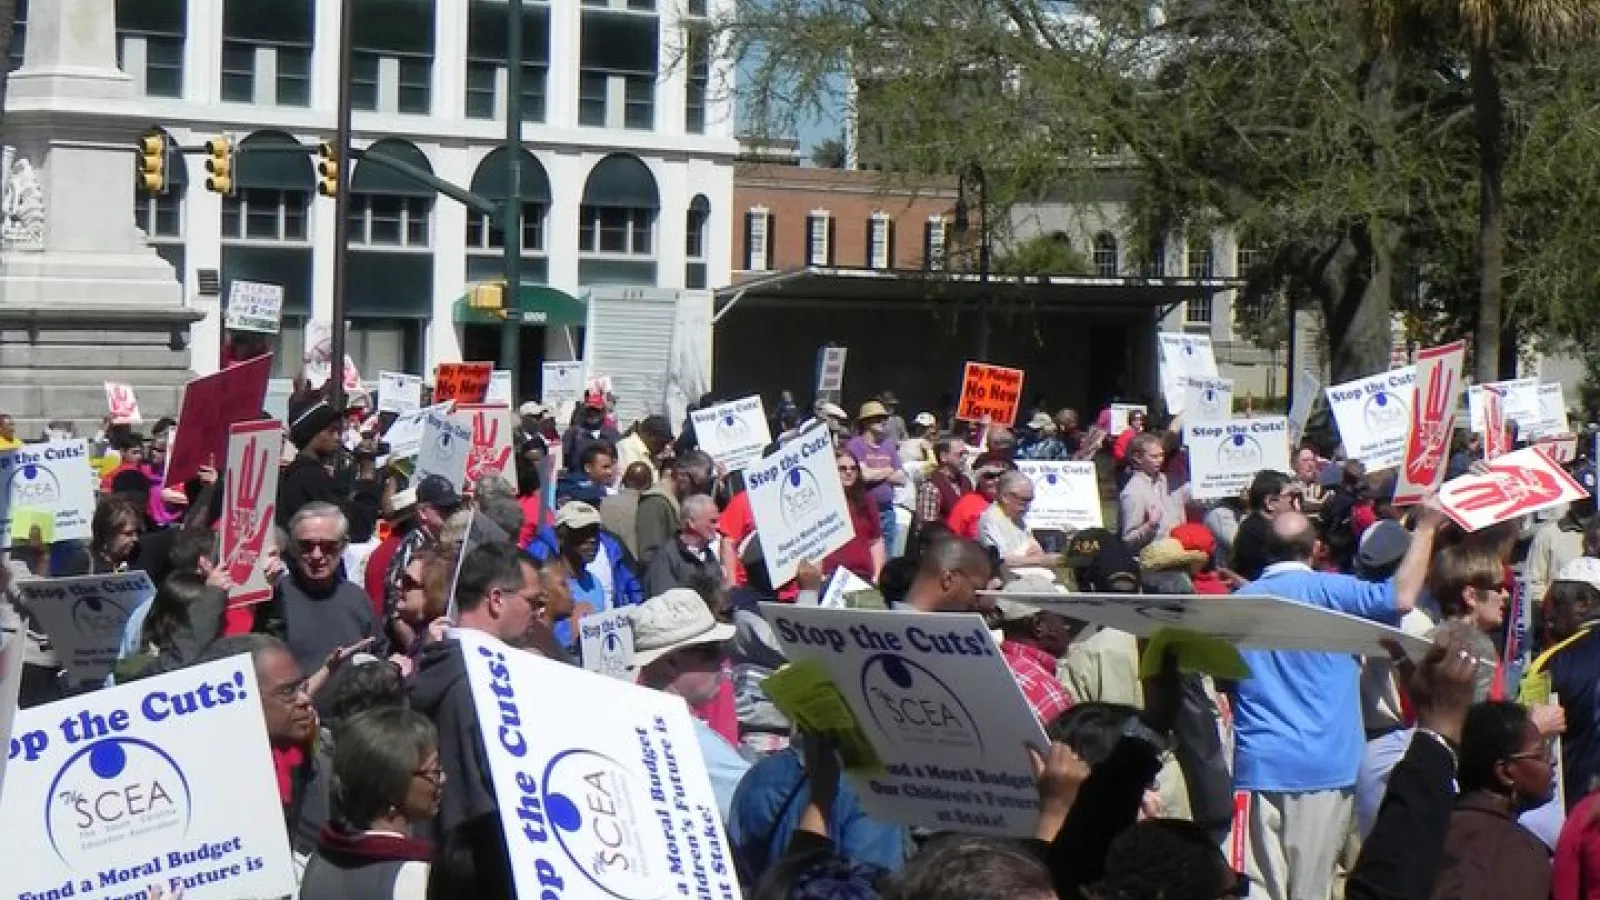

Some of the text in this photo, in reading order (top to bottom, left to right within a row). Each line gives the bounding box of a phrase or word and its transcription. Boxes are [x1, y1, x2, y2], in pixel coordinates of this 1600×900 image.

[967, 381, 1018, 402] No New
[1331, 389, 1362, 403] Stop
[1192, 421, 1284, 437] Stop the Cuts!
[15, 443, 84, 463] the Cuts!
[749, 466, 778, 490] Stop
[780, 453, 799, 470] the
[801, 432, 828, 458] Cuts!
[24, 577, 150, 599] Stop the Cuts!
[775, 617, 993, 656] Stop the Cuts!
[9, 671, 247, 761] op the Cuts!
[653, 715, 667, 733] is
[884, 698, 964, 728] SCEA
[478, 646, 564, 900] op the Cuts!
[661, 738, 689, 812] Future
[75, 780, 173, 828] SCEA
[583, 771, 629, 871] SCEA
[635, 727, 688, 895] a Moral Budget
[697, 805, 728, 876] Stake!
[81, 878, 93, 892] a
[98, 857, 162, 888] Moral
[167, 836, 242, 869] Budget
[169, 861, 241, 893] Future
[245, 855, 264, 871] is
